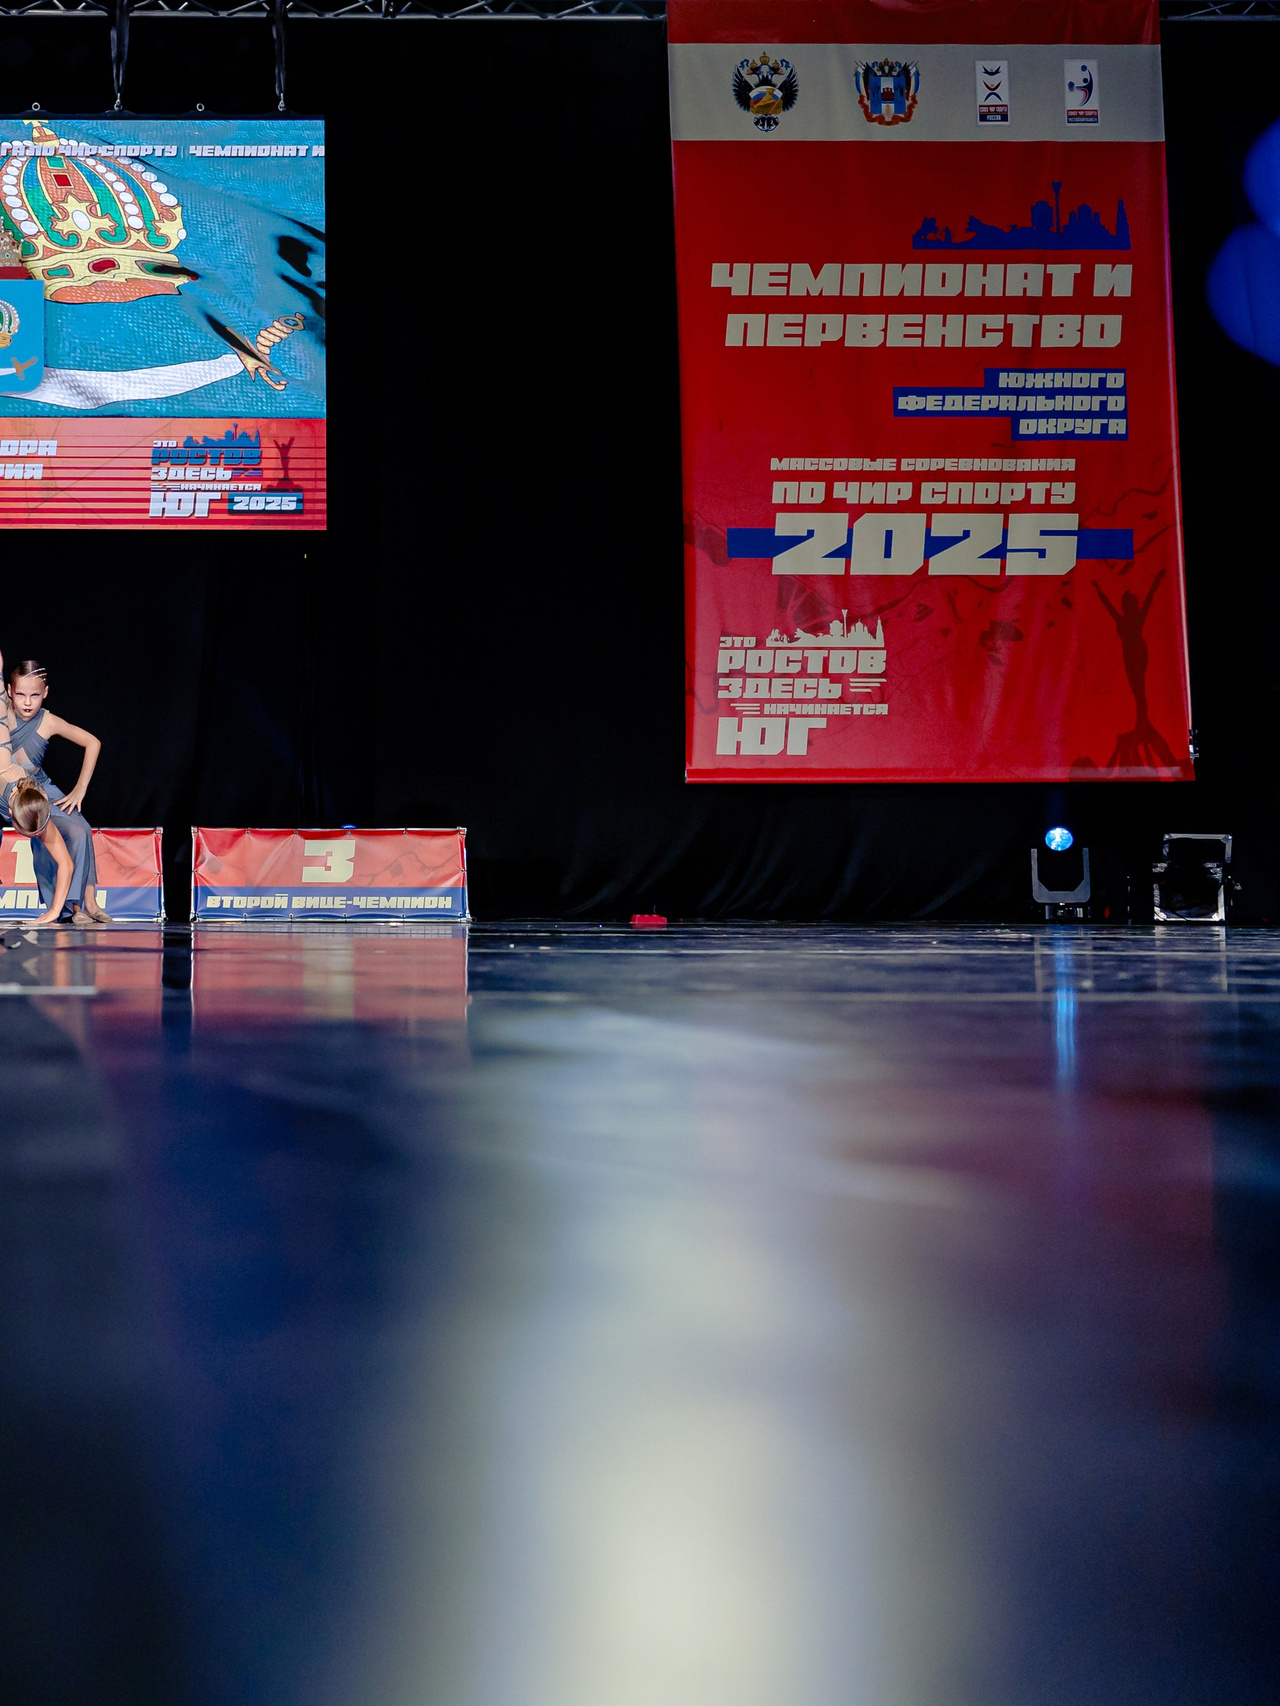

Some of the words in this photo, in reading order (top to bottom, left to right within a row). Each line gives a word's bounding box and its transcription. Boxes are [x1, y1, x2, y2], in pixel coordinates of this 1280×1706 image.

[29, 145, 55, 156] ПО
[60, 145, 97, 156] ЧИР
[102, 144, 177, 157] СПОРТУ
[189, 145, 308, 157] ЧЕМПИОНАТ
[312, 145, 325, 157] И
[710, 263, 1081, 297] ЧЕМПИОНАТ
[1093, 263, 1133, 297] И
[724, 313, 1123, 348] ПЕРВЕНСТВО
[998, 372, 1125, 388] ЮЖНОГО
[897, 395, 1126, 411] ФЕДЕРАЛЬНОГО
[1019, 418, 1126, 435] ОКРУГА
[151, 449, 261, 465] РОСТОВ
[770, 457, 897, 471] МАССОВЫЕ
[900, 458, 1076, 472] СОРЕВНОВАНИЯ
[150, 468, 232, 480] ЗДЕСЬ
[181, 483, 261, 491] НАЧИНАЕТСЯ
[771, 481, 826, 505] ПО
[832, 481, 913, 505] ЧИР
[920, 482, 1076, 505] СПОРТУ
[149, 493, 221, 517] ЮГ
[233, 496, 297, 510] 2025
[771, 512, 1079, 576] 2025
[719, 636, 756, 648] ЭТО
[717, 649, 887, 674] РОСТОВ
[717, 678, 842, 699] ЗДЕСЬ
[763, 704, 888, 716] НАЧИНАЕТСЯ
[716, 717, 827, 756] ЮГ
[10, 840, 38, 884] 1
[302, 839, 356, 883] 3
[207, 893, 288, 909] ВТОРОЙ
[291, 896, 452, 909] ВИЦЕ-ЧЕМПИОН
